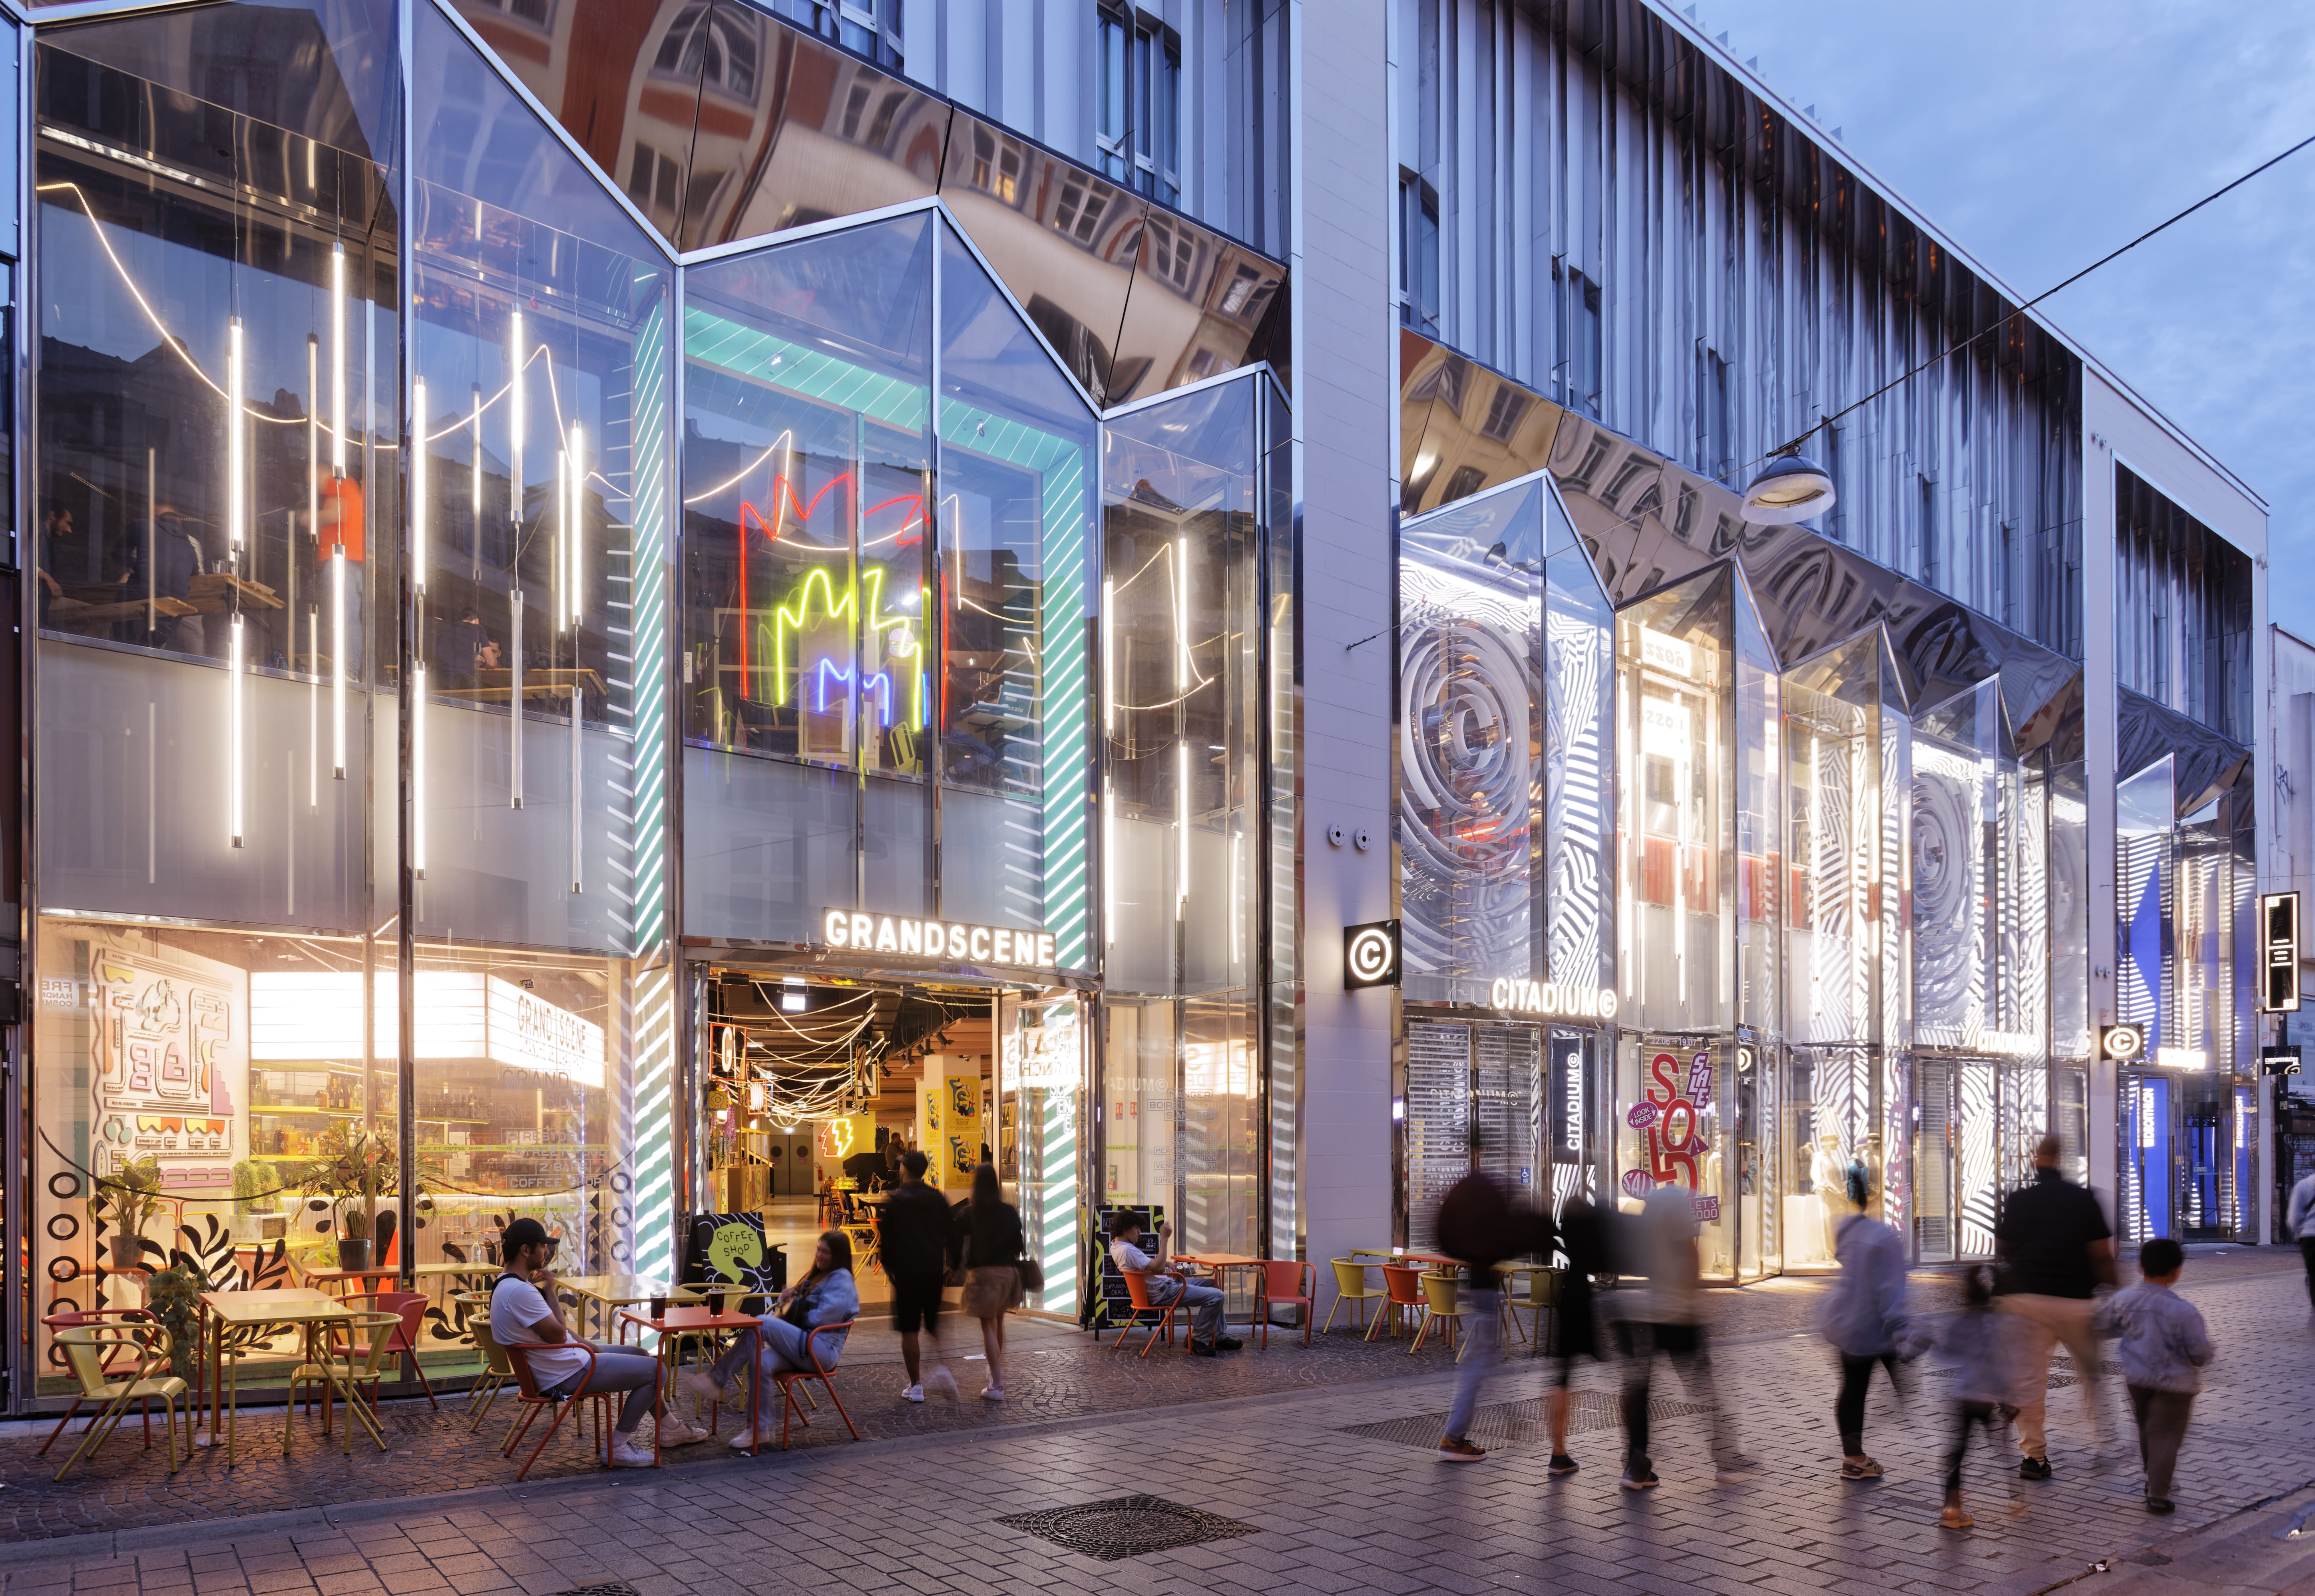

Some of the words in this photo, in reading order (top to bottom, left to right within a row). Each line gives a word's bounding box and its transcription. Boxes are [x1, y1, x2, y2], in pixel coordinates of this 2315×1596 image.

[825, 911, 1053, 967] GRANDSCENE
[518, 995, 552, 1041] GRAND
[559, 1014, 586, 1055] SCENE
[1651, 1037, 1671, 1045] 22.06
[1678, 1038, 1697, 1047] 19.07
[502, 1069, 570, 1089] GRAND
[1688, 1055, 1710, 1106] SALE
[545, 1093, 608, 1111] SCENE
[1634, 1107, 1650, 1119] LOOK
[1634, 1113, 1653, 1125] INSIDE
[505, 1132, 518, 1141] 10
[523, 1132, 575, 1141] RESTOS
[539, 1163, 548, 1172] 2
[553, 1162, 588, 1172] BARS
[510, 1177, 563, 1188] COFFEE
[568, 1177, 602, 1187] SHOP
[1689, 1198, 1717, 1210] LET'S
[717, 1230, 754, 1243] COFFEE
[723, 1243, 750, 1257] SHOP
